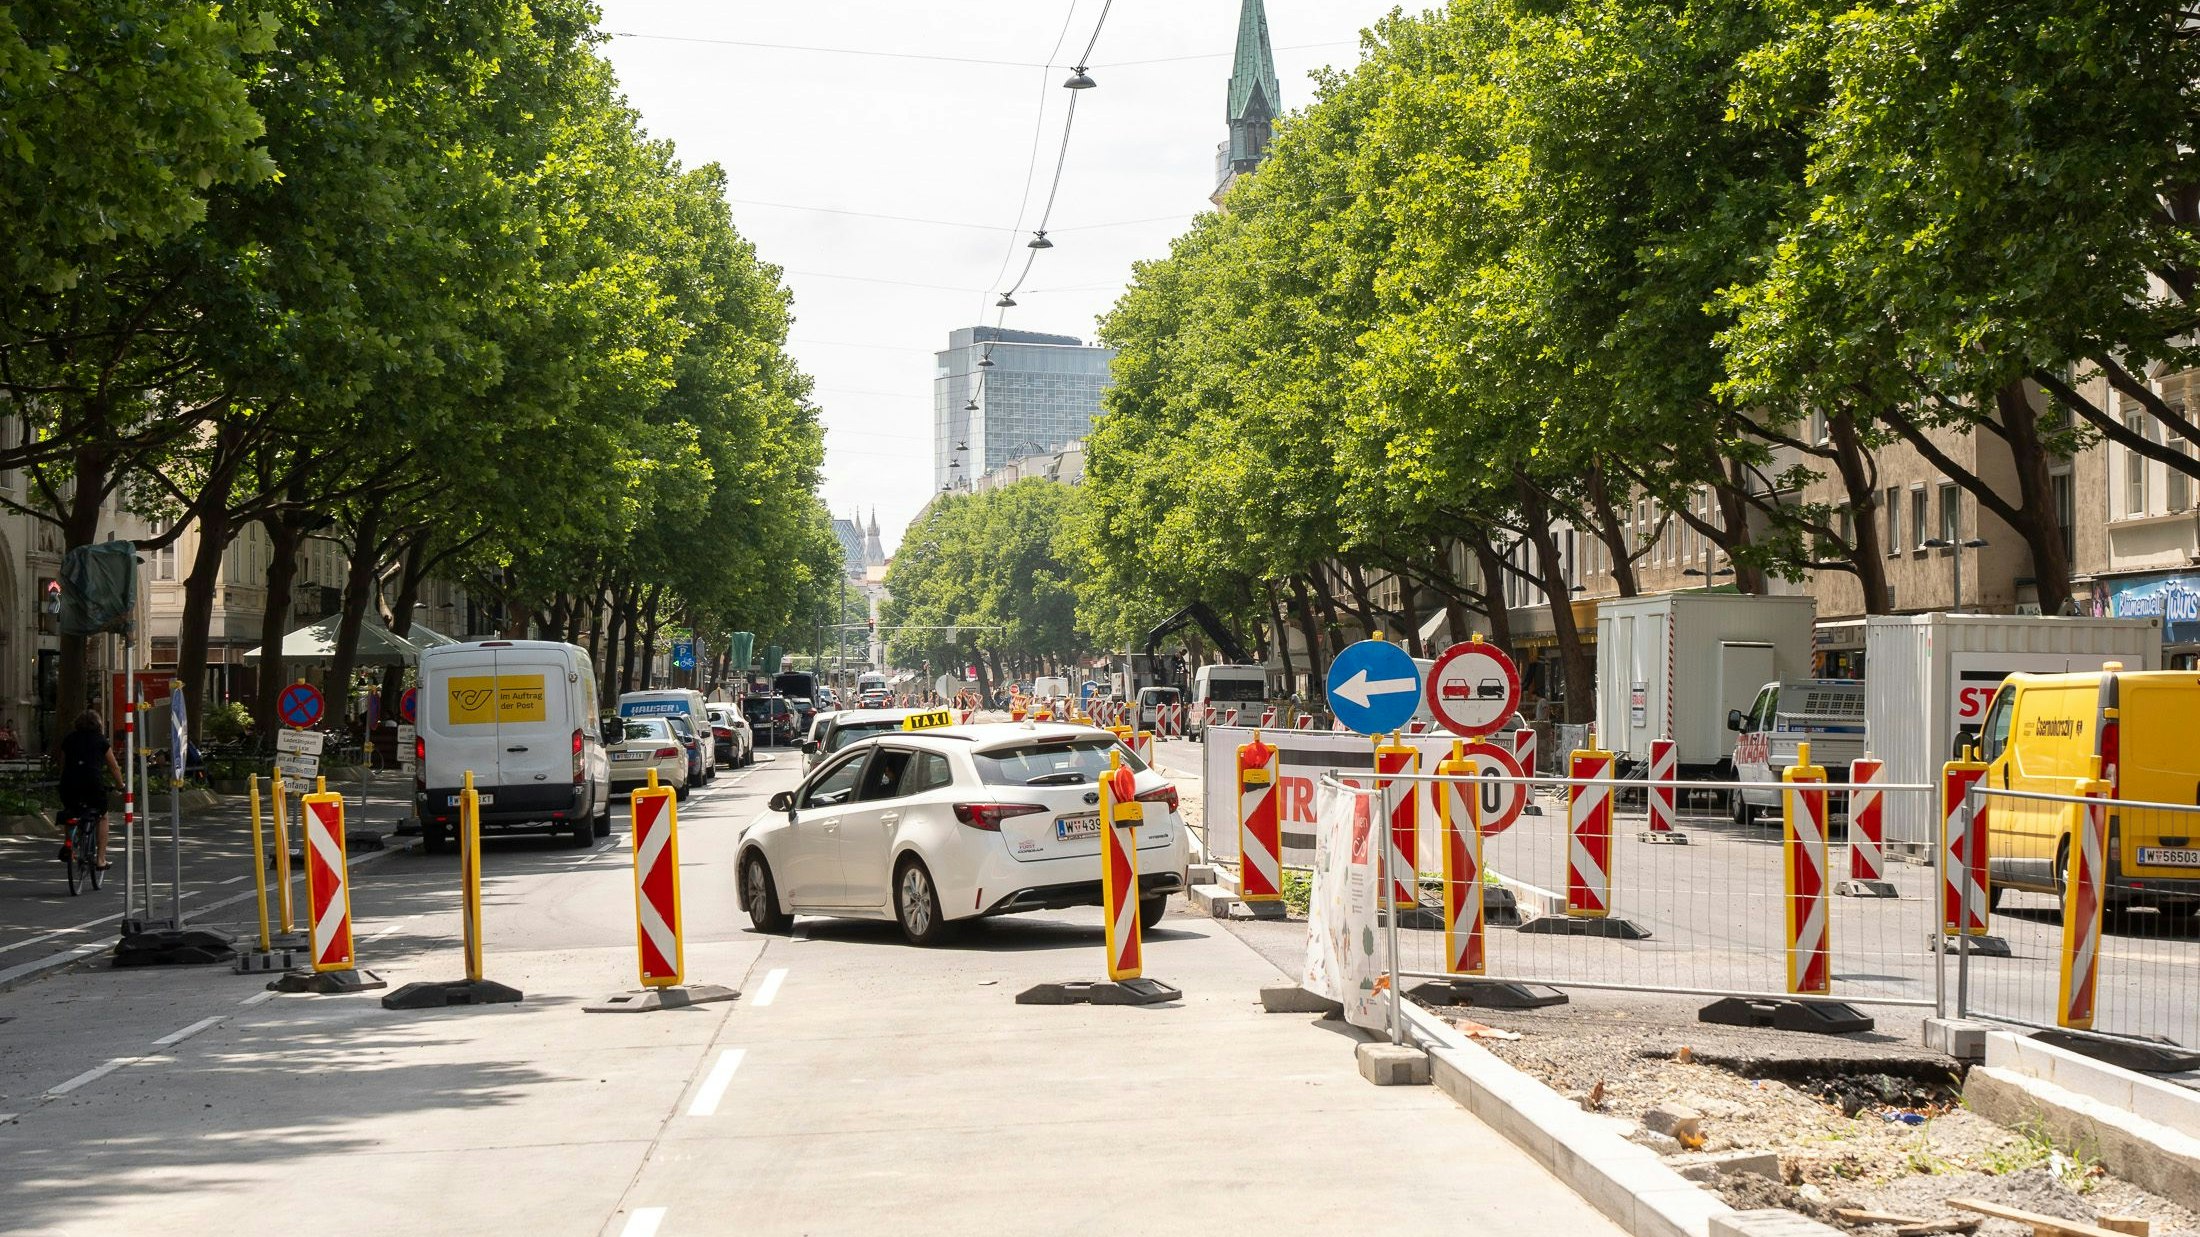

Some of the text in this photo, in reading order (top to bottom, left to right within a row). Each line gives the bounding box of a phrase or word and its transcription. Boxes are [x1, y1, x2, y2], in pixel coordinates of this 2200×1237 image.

[2165, 581, 2198, 620] Twins
[680, 648, 687, 657] P
[512, 692, 543, 701] Auftrag
[1959, 687, 1999, 717] ST
[501, 702, 514, 710] der
[631, 704, 675, 713] HAUSER
[912, 712, 947, 728] TAXI
[1481, 766, 1501, 814] 0
[1065, 817, 1101, 833] W 439
[2146, 850, 2198, 863] W 56503
